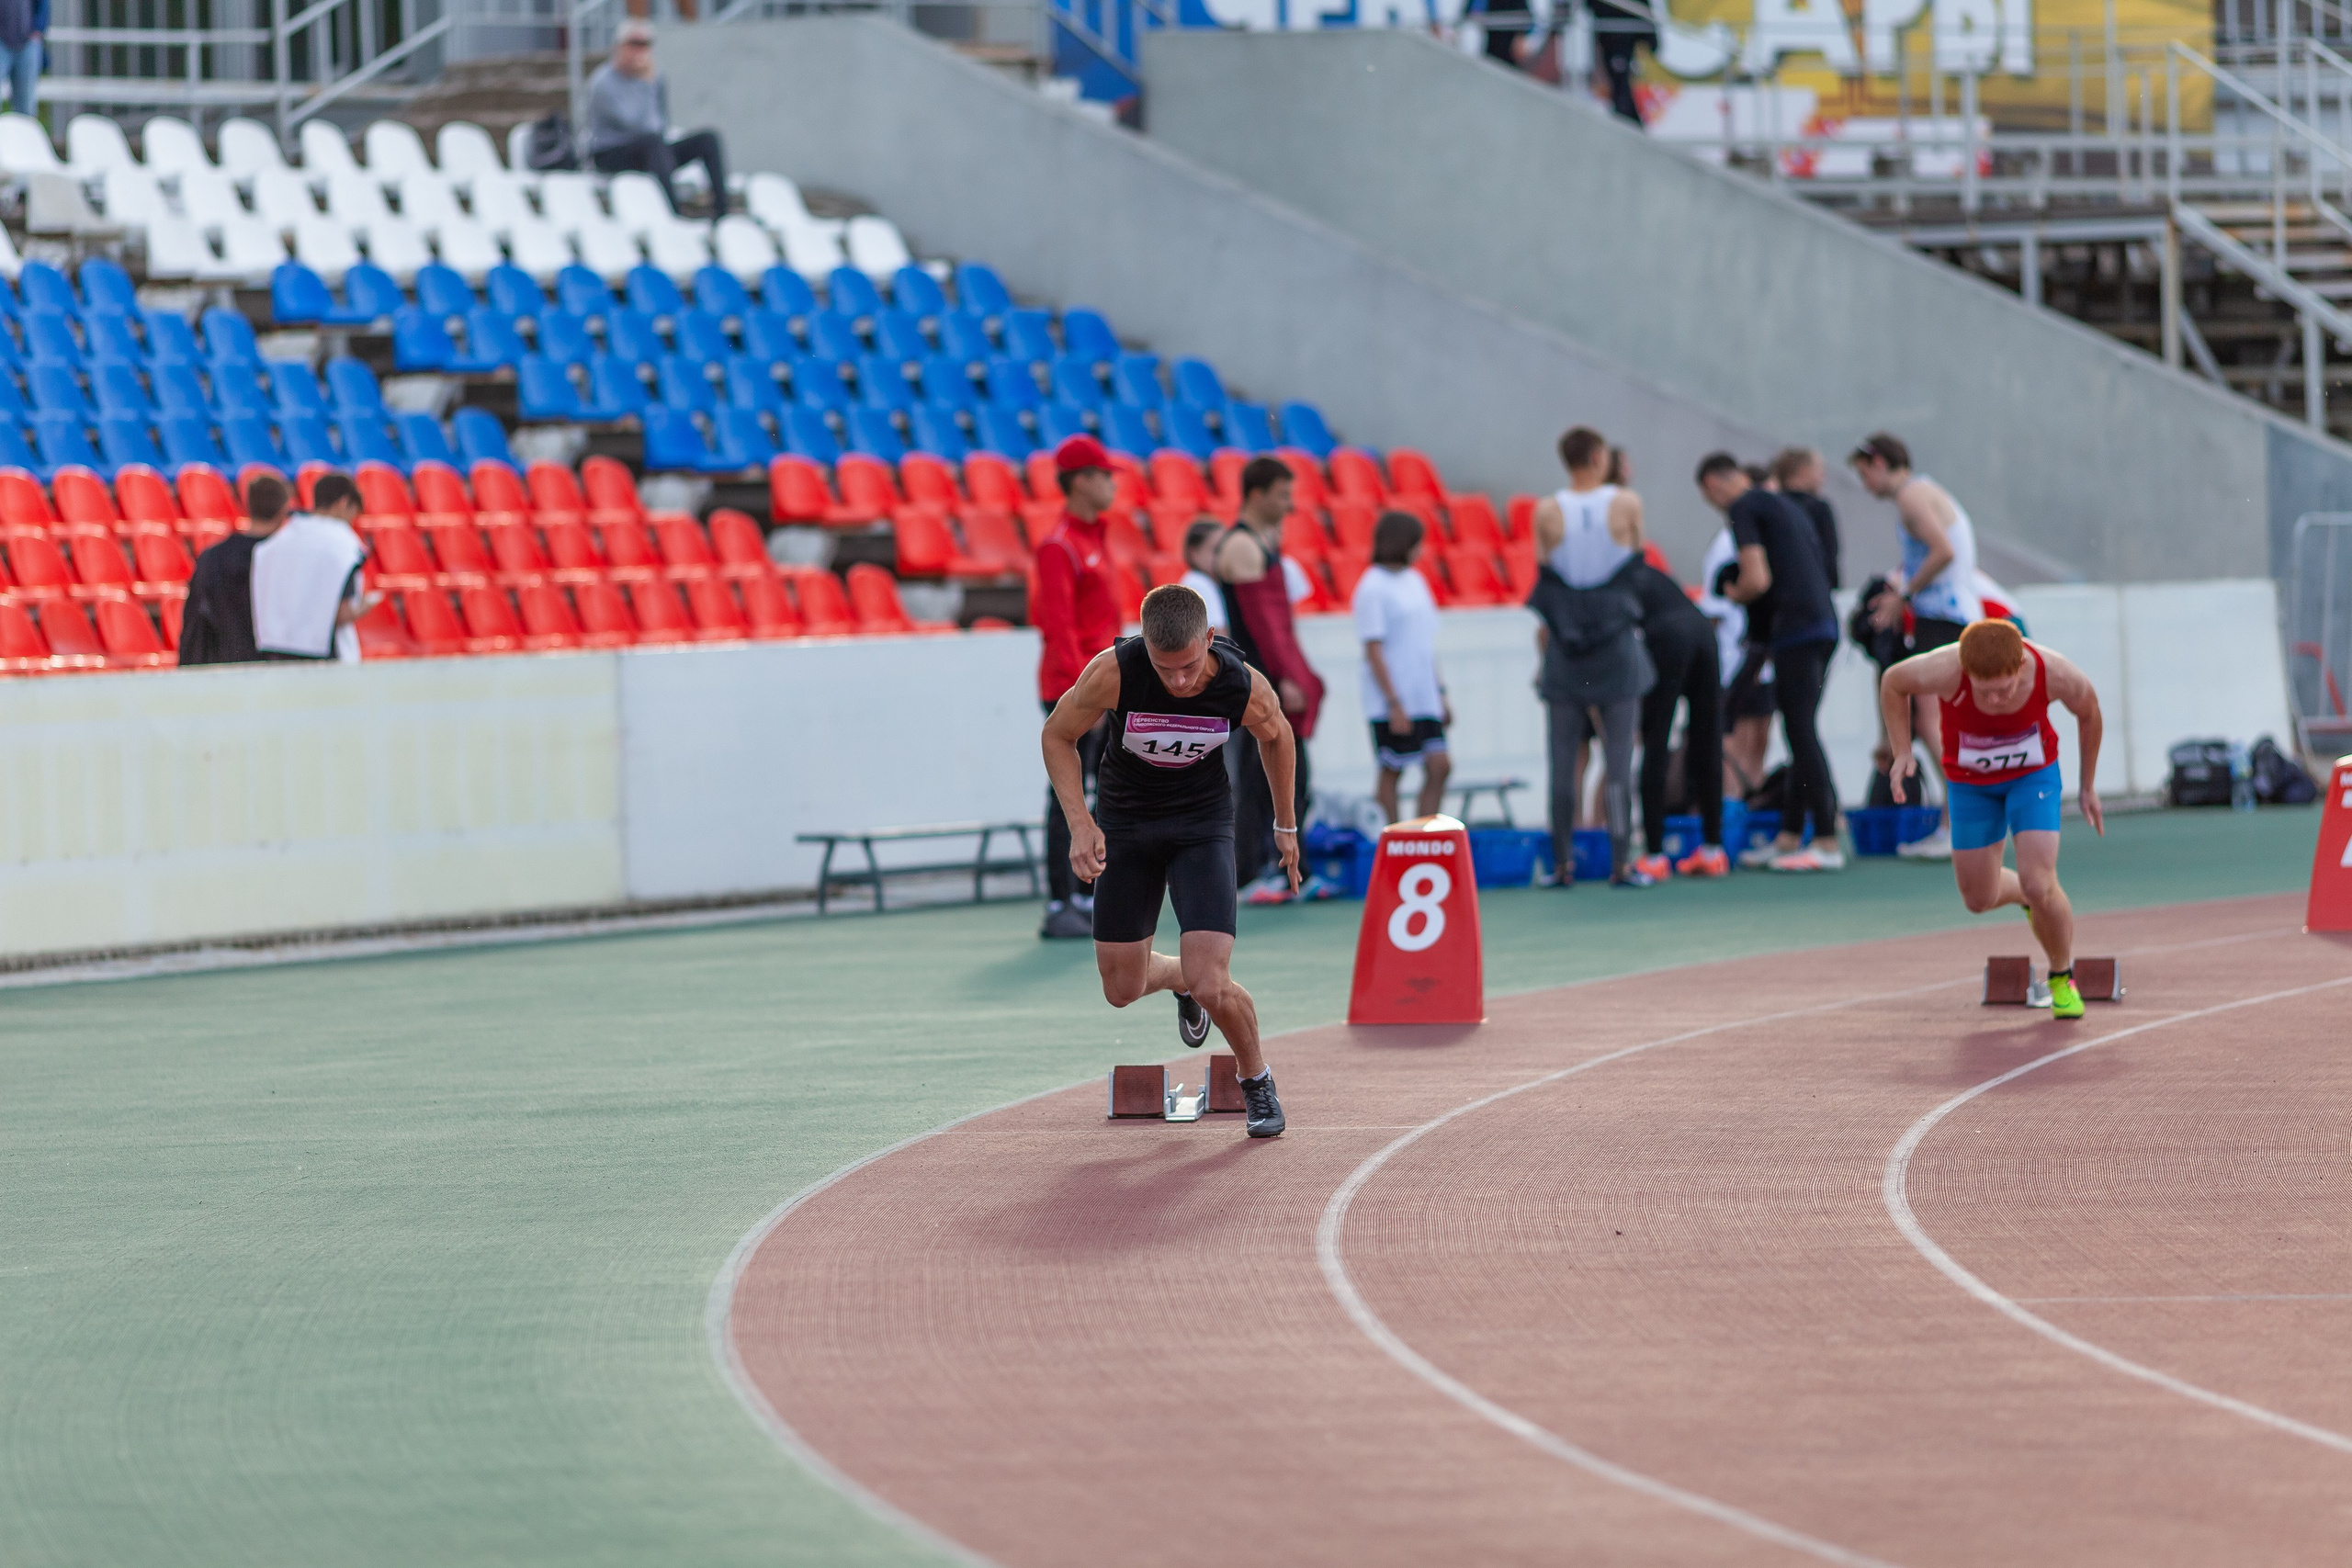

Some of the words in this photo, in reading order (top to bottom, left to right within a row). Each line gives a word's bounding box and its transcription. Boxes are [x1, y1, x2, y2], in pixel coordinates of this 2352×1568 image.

[1142, 739, 1206, 758] 145
[1386, 840, 1456, 856] MONDO
[1387, 862, 1453, 952] 8
